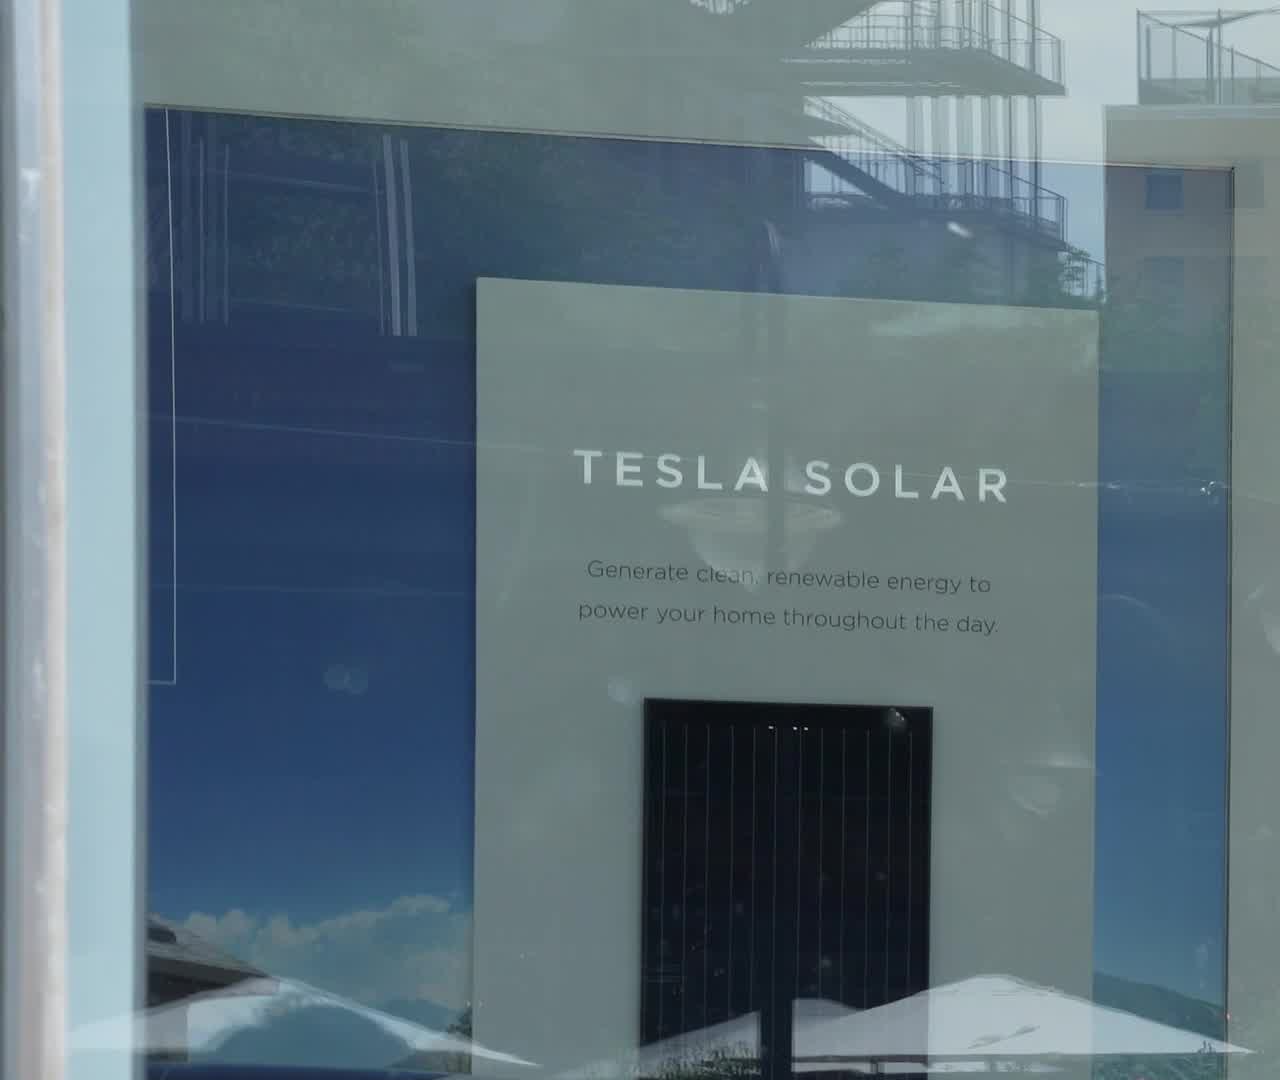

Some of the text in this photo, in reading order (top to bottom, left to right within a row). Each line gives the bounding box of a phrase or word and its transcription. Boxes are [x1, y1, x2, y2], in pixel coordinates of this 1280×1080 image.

[573, 449, 1008, 503] TESLA SOLAR
[586, 560, 689, 582] Generate
[767, 569, 880, 590] renewable
[887, 575, 962, 595] energy
[969, 576, 992, 593] to
[578, 603, 999, 637] power your home throughout the day.
